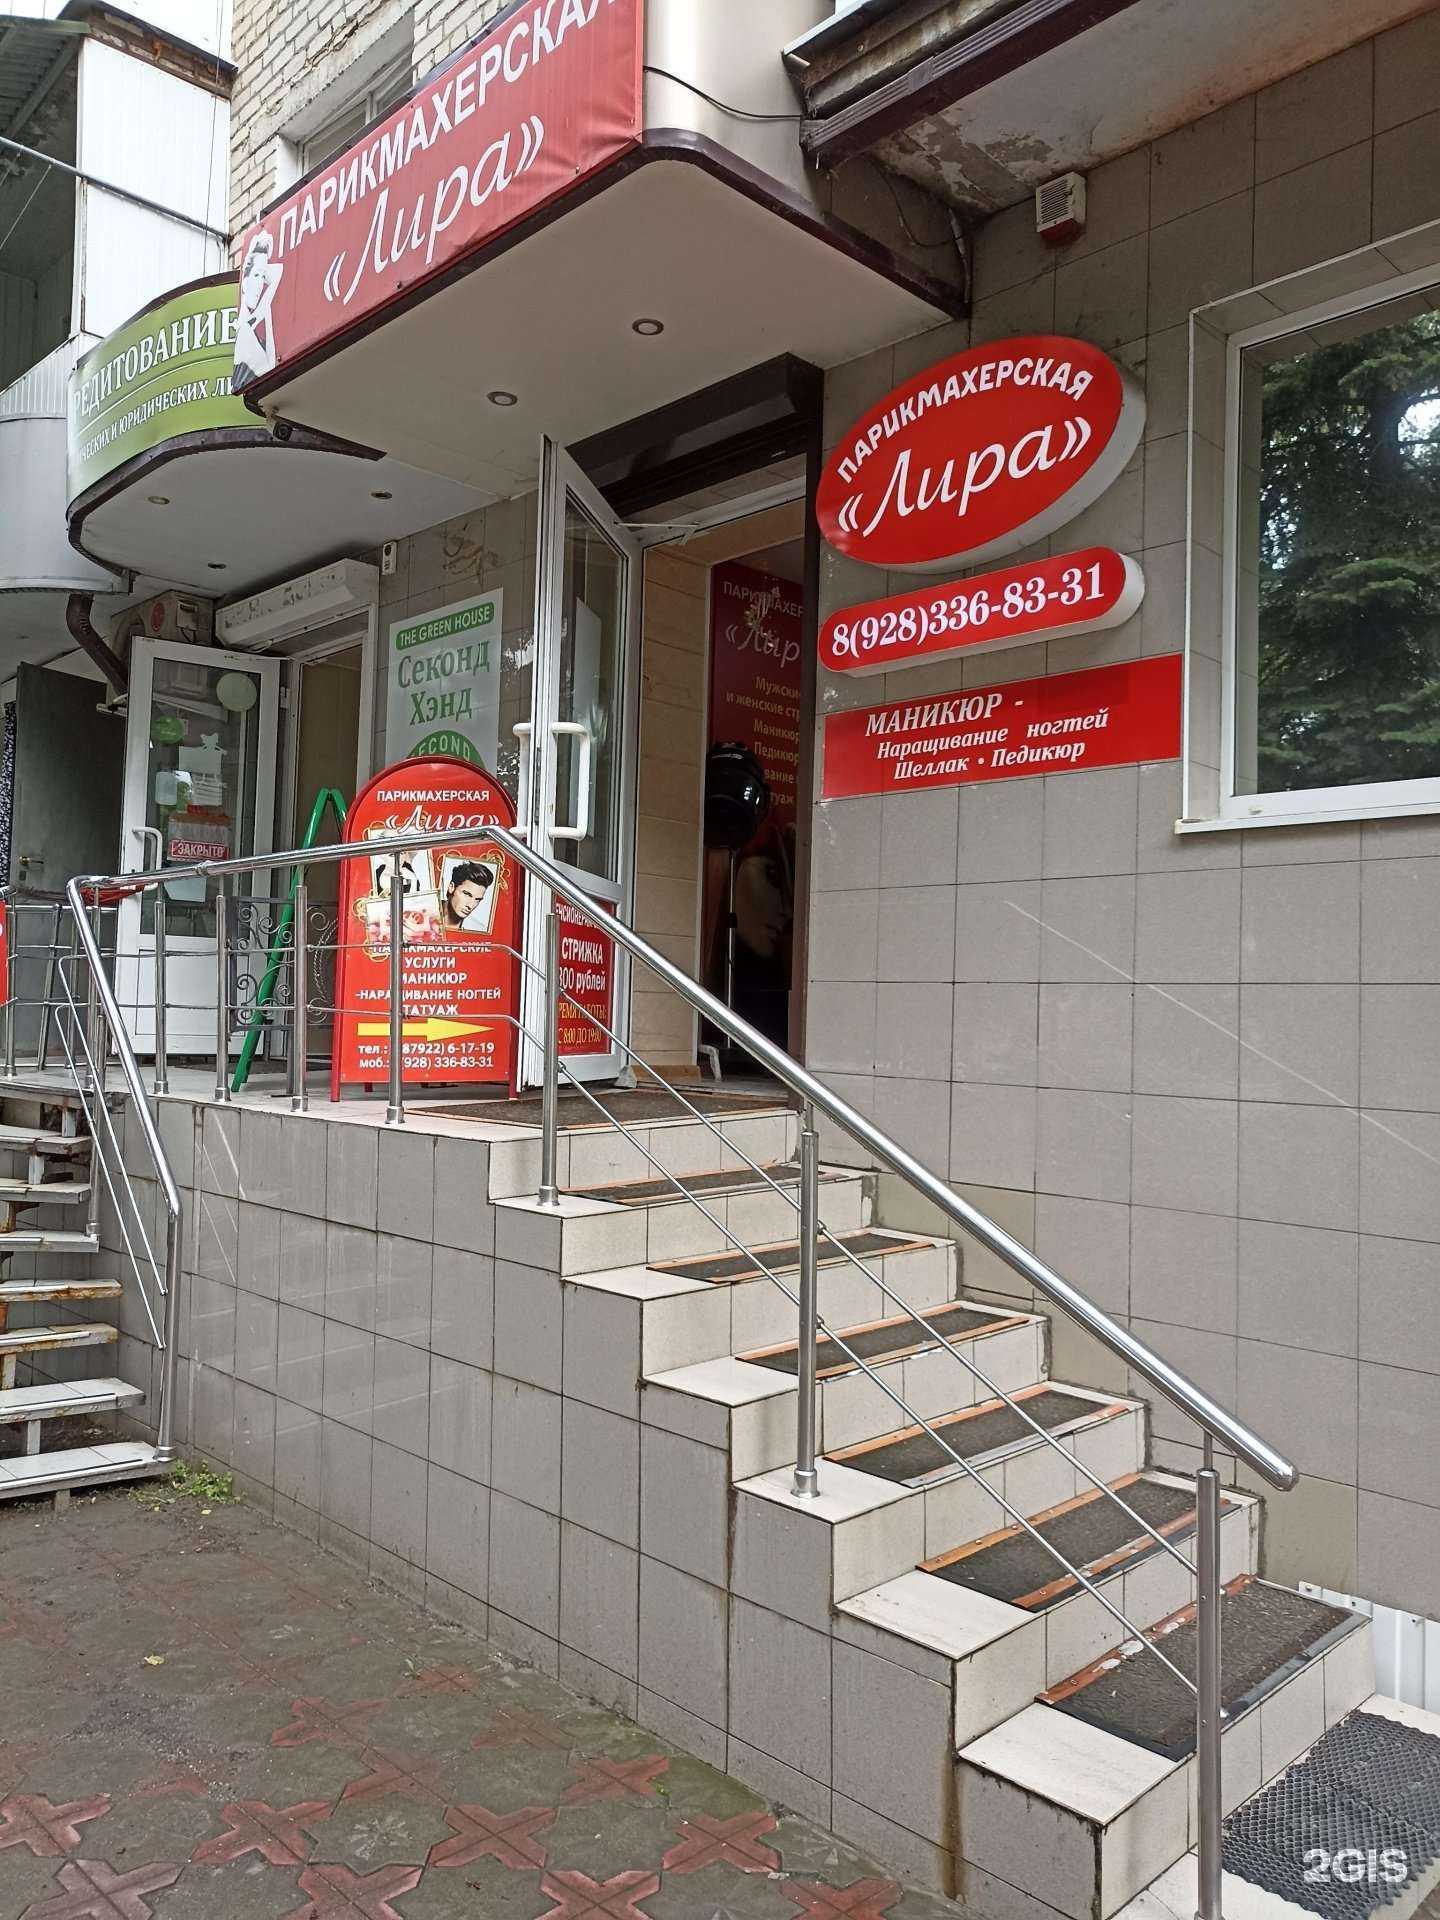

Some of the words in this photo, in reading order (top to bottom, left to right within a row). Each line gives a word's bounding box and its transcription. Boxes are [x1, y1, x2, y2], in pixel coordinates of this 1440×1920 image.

[279, 0, 616, 258] ПАРИКМАХЕРСКА
[323, 115, 545, 304] «Лира»
[72, 307, 239, 426] РЕДИТОВАНИЕ
[80, 427, 110, 463] ЧЕСКИХ
[111, 421, 118, 441] И
[119, 379, 209, 434] ЮРИДИЧЕСКИХ
[837, 357, 1094, 484] ПАРИКМАХЕРСКАЯ
[838, 416, 1092, 538] «Лира»
[400, 632, 417, 647] THE
[419, 619, 452, 640] GREEN
[455, 605, 491, 630] HOUSE
[832, 562, 1105, 659] 8(928)336-83-31
[398, 640, 491, 688] Секонд
[726, 691, 734, 702] и
[736, 696, 783, 715] женские
[755, 676, 801, 697] Мужски
[409, 687, 473, 726] Хэнд
[865, 692, 1003, 738] МАНИКЮР
[411, 734, 470, 761] ECOND
[877, 726, 1009, 760] Наращивание
[1027, 708, 1109, 739] ногтей
[763, 767, 794, 784] вание
[894, 756, 970, 780] Шеллак
[990, 742, 1086, 768] Педикюр
[377, 790, 490, 802] ПАРИКМАХЕРСКАЯ
[177, 842, 225, 858] ЗАКРЫТО
[404, 956, 456, 969] УСЛУГИ
[561, 936, 604, 964] СТРИЖКА
[355, 989, 453, 1001] -НАРАИВАНИЕ
[457, 986, 501, 1000] НОГТЕЙ
[576, 968, 606, 994] рублей
[434, 1056, 494, 1068] 336-83-31
[447, 1042, 495, 1054] 6-17-19
